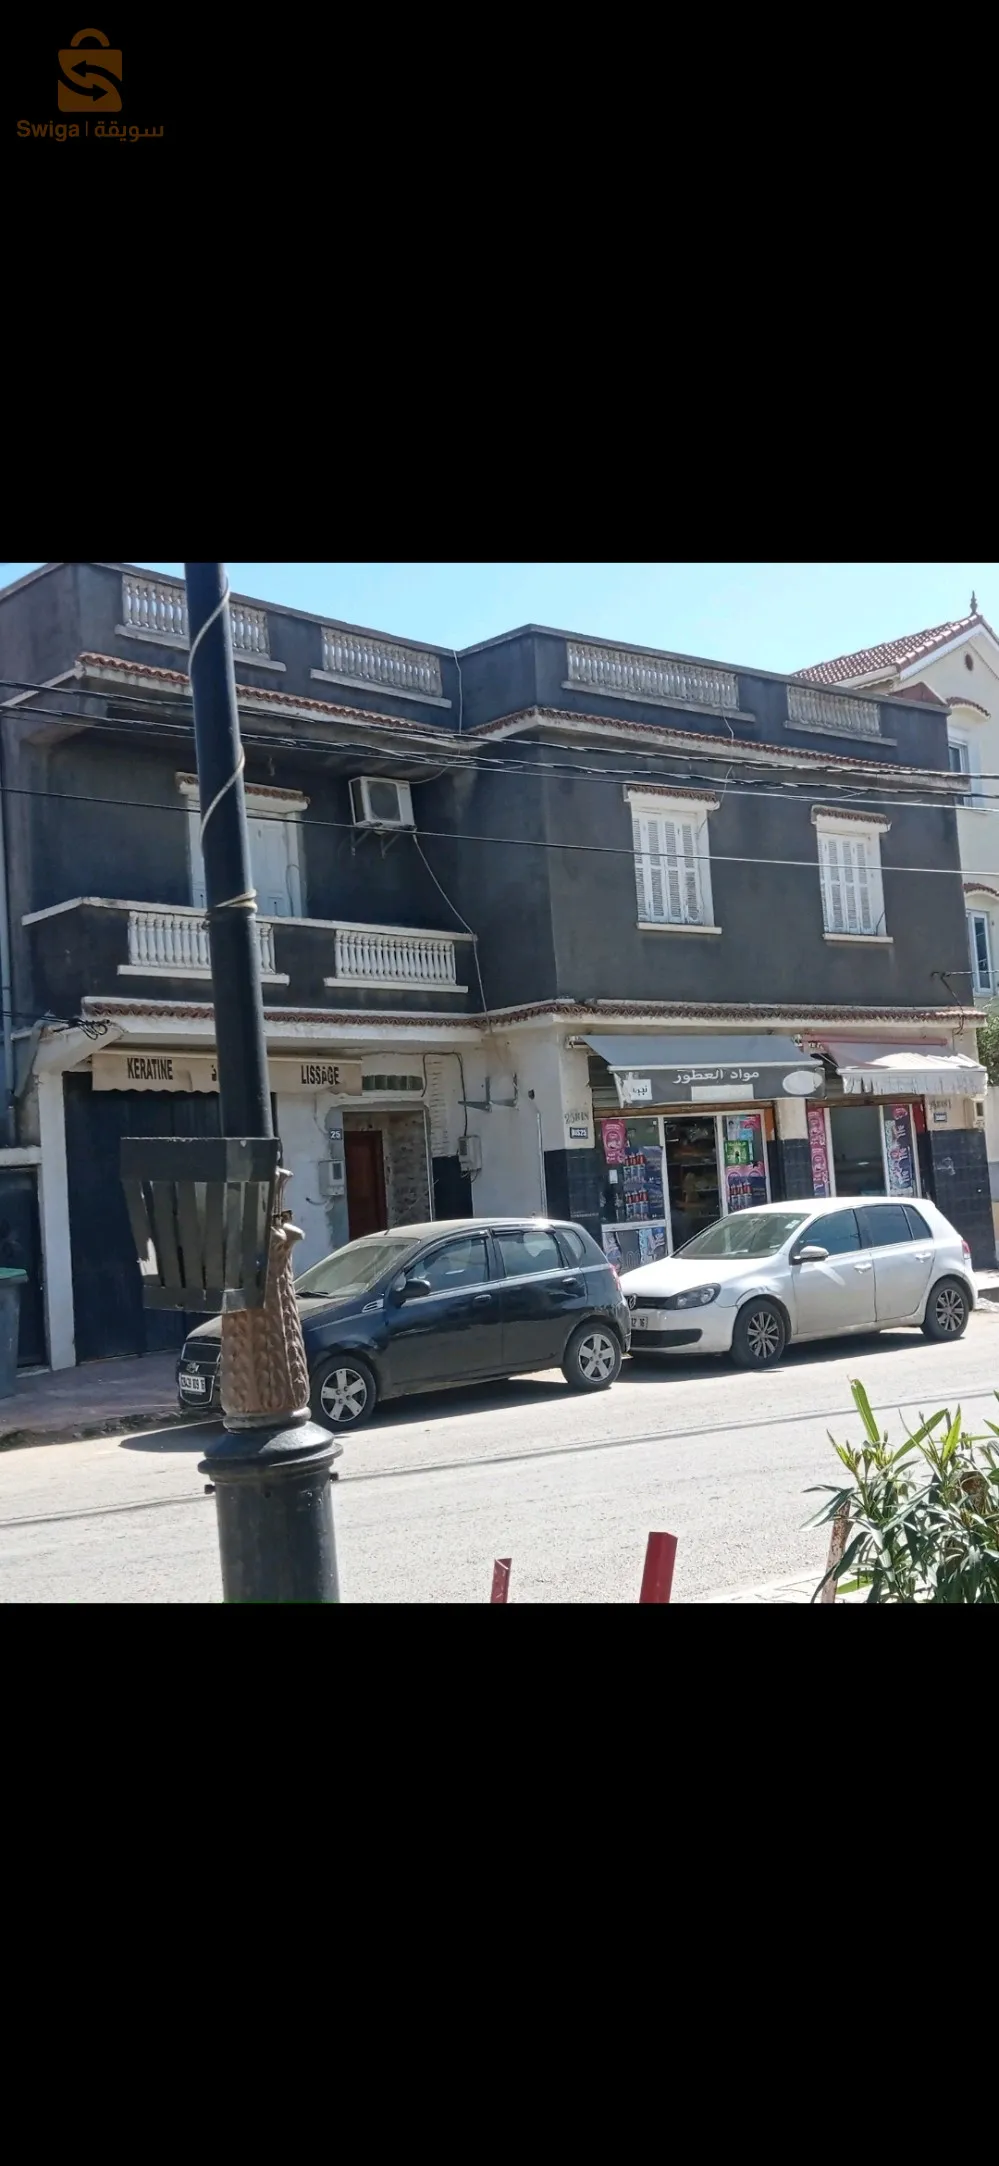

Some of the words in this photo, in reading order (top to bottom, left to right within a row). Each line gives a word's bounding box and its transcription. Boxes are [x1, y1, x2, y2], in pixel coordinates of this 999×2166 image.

[126, 1057, 174, 1080] KERATINE
[301, 1065, 341, 1085] LISSAGE
[672, 1068, 724, 1084] العطور
[730, 1068, 760, 1082] مواد
[330, 1130, 341, 1139] 25
